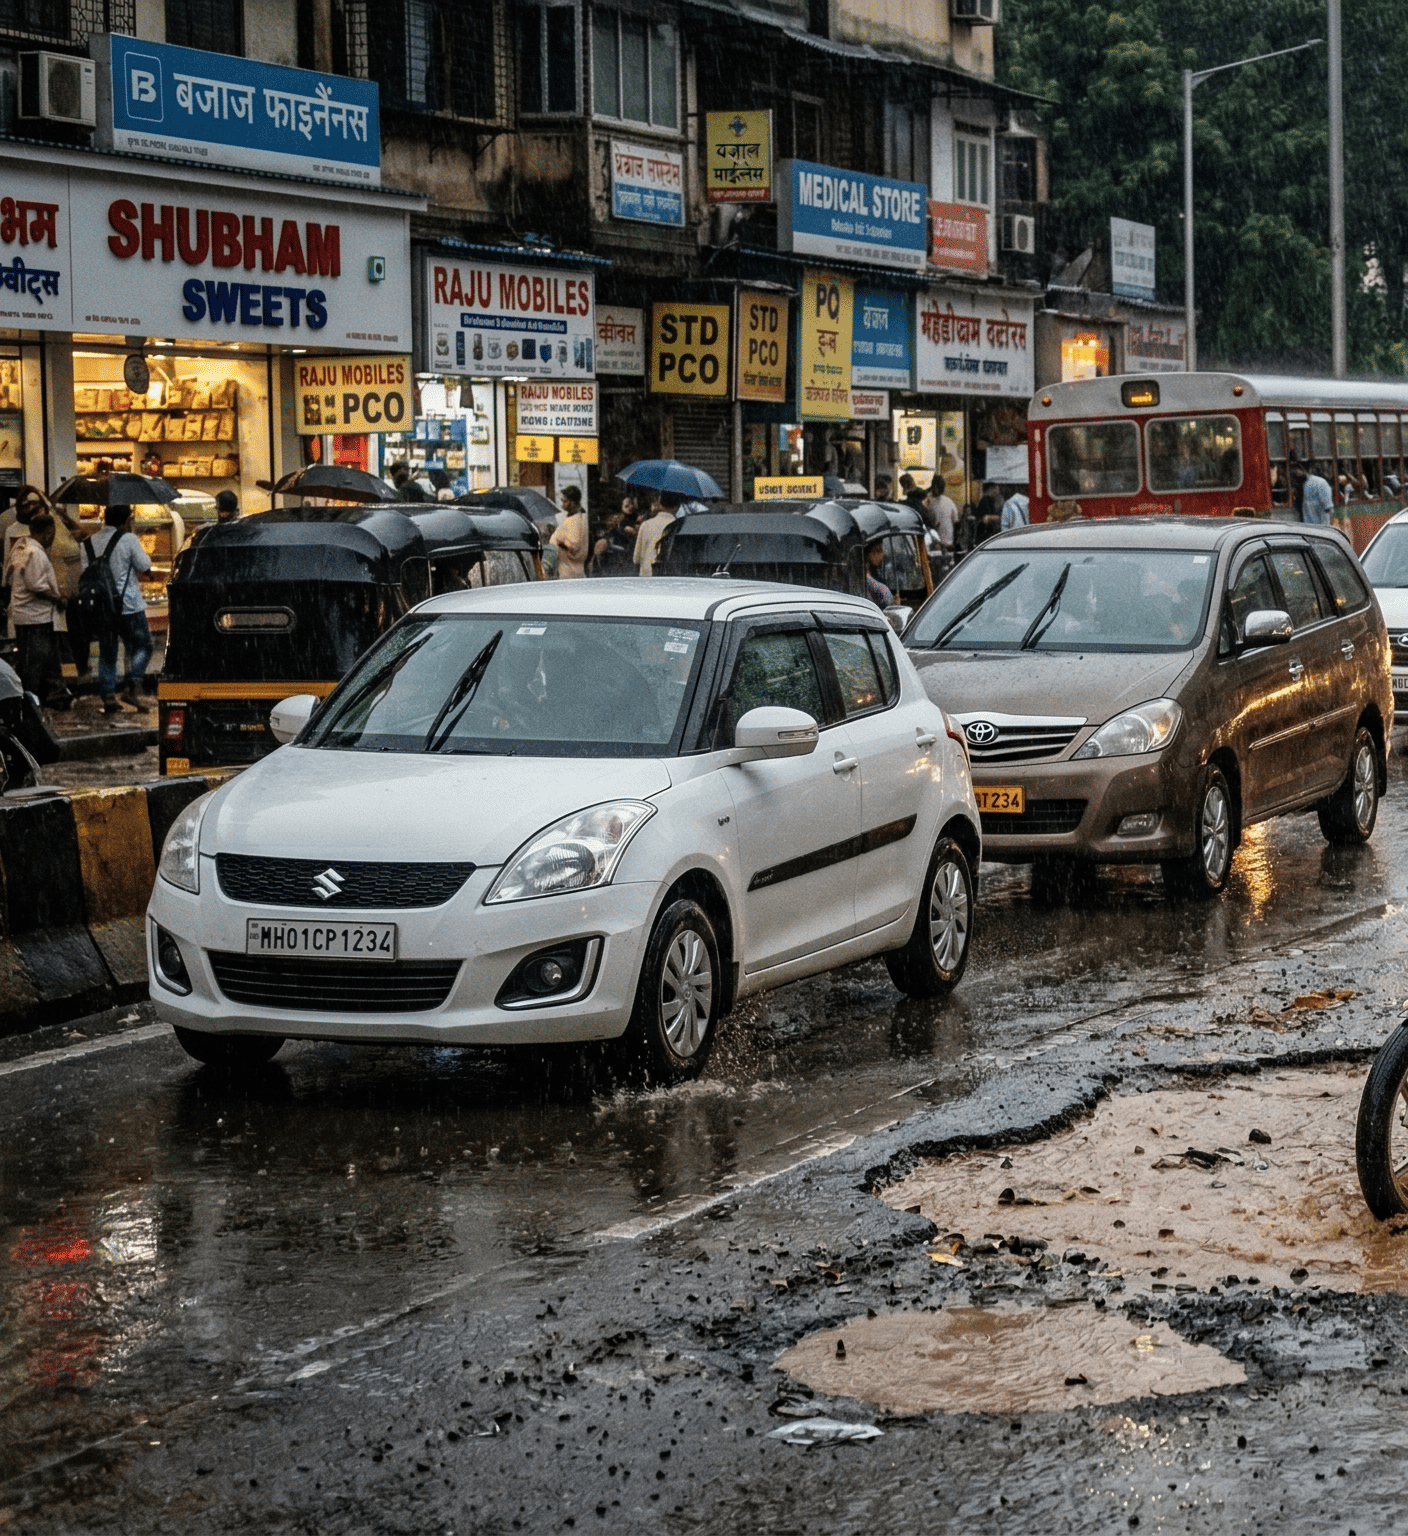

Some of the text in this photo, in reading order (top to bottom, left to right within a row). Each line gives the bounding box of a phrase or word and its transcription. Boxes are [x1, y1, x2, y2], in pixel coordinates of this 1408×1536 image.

[173, 72, 256, 124] बजाज
[799, 171, 921, 225] MEDICAL STORE
[107, 198, 342, 278] SHUBHAM
[182, 278, 329, 331] SWEETS
[433, 265, 590, 317] RAJU MOBILES
[660, 313, 719, 345] STD
[750, 303, 779, 333] STD
[658, 352, 720, 385] PCO
[748, 338, 779, 367] PCO
[299, 363, 405, 388] RAJU MOBILES
[342, 391, 406, 425] PCO
